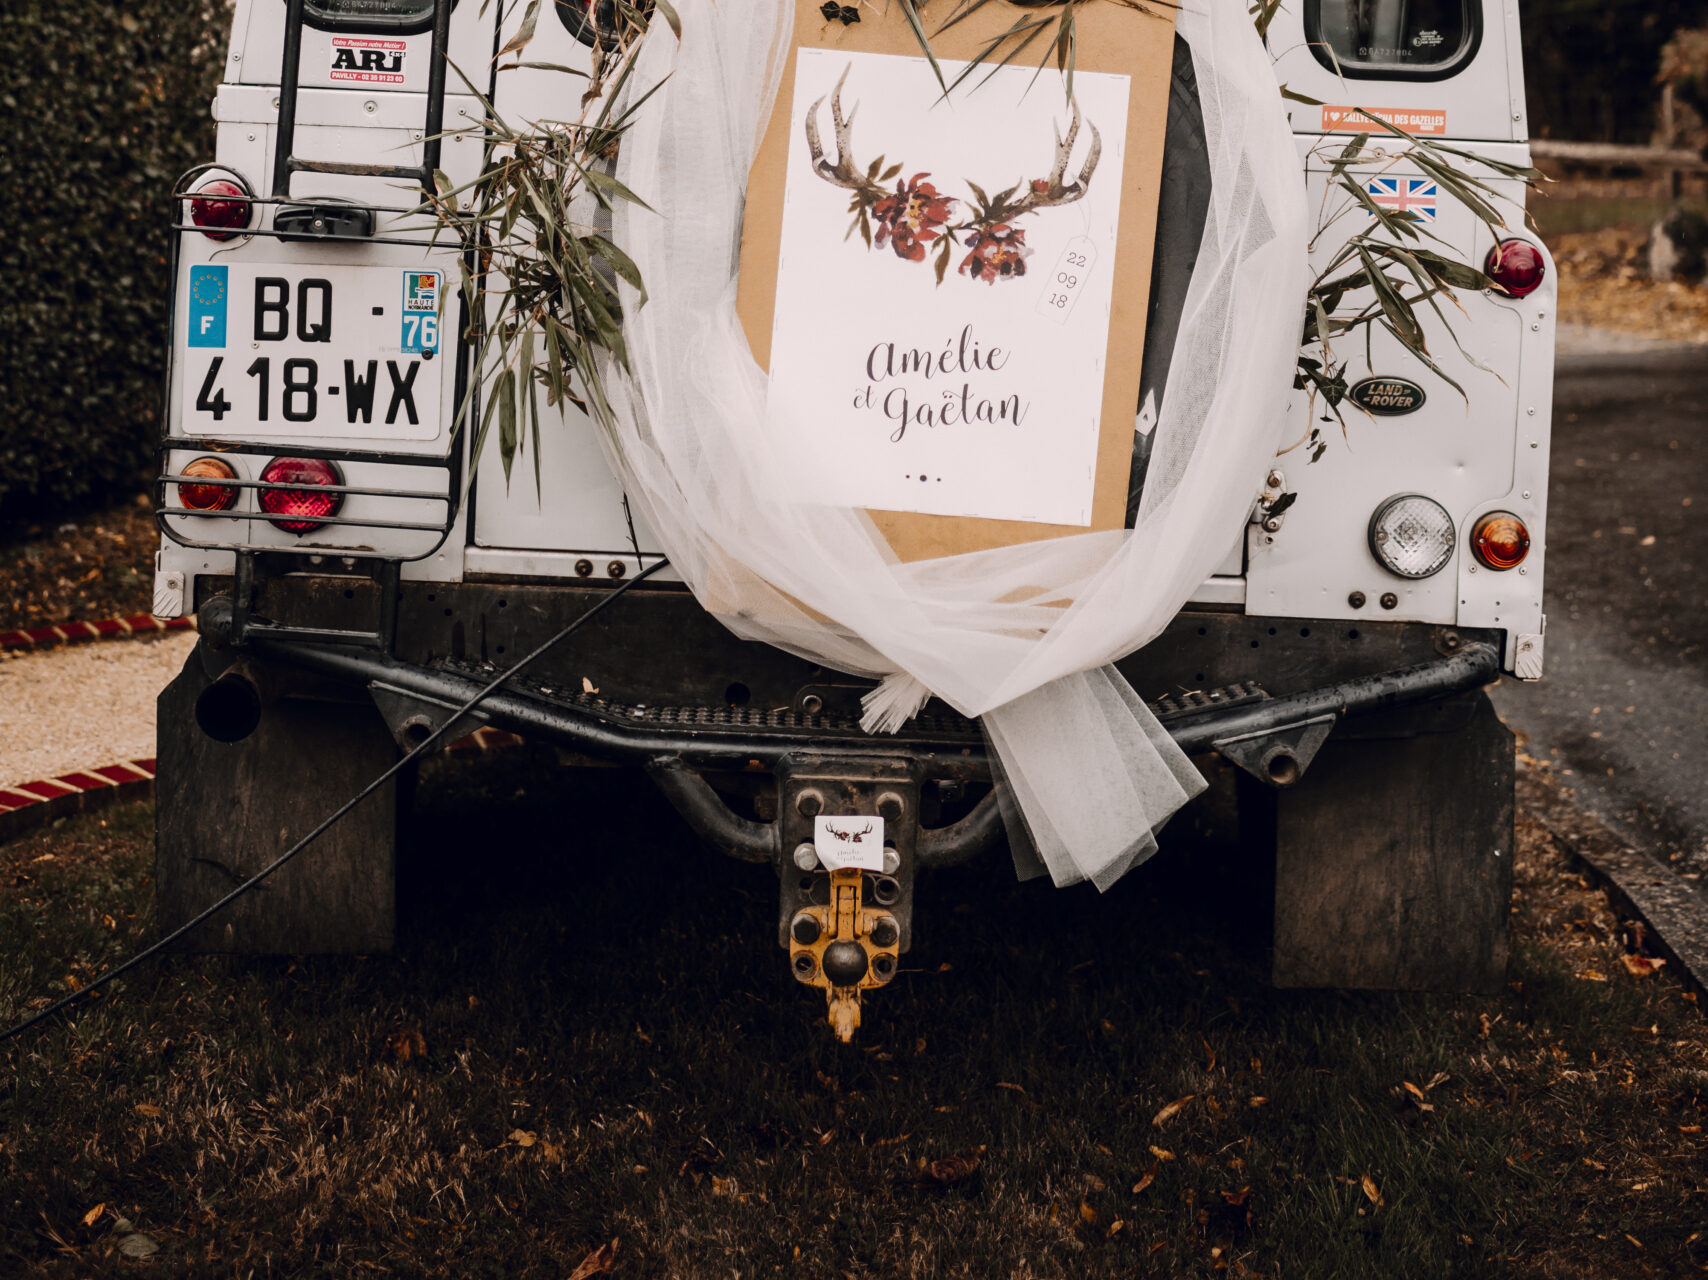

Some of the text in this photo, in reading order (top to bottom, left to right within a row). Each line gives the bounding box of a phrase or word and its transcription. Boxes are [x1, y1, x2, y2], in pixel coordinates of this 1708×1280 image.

[347, 39, 368, 47] Passion
[332, 72, 357, 80] PAVILLY
[1394, 114, 1409, 126] DES
[1409, 115, 1444, 127] GAZELLES
[1066, 251, 1087, 268] 22
[1057, 271, 1078, 289] 09
[253, 276, 333, 343] BQ
[1048, 293, 1068, 309] 18
[200, 315, 215, 335] F
[403, 315, 438, 348] 76
[866, 323, 1011, 382] Amélie
[853, 383, 1031, 443] et Gaëtan
